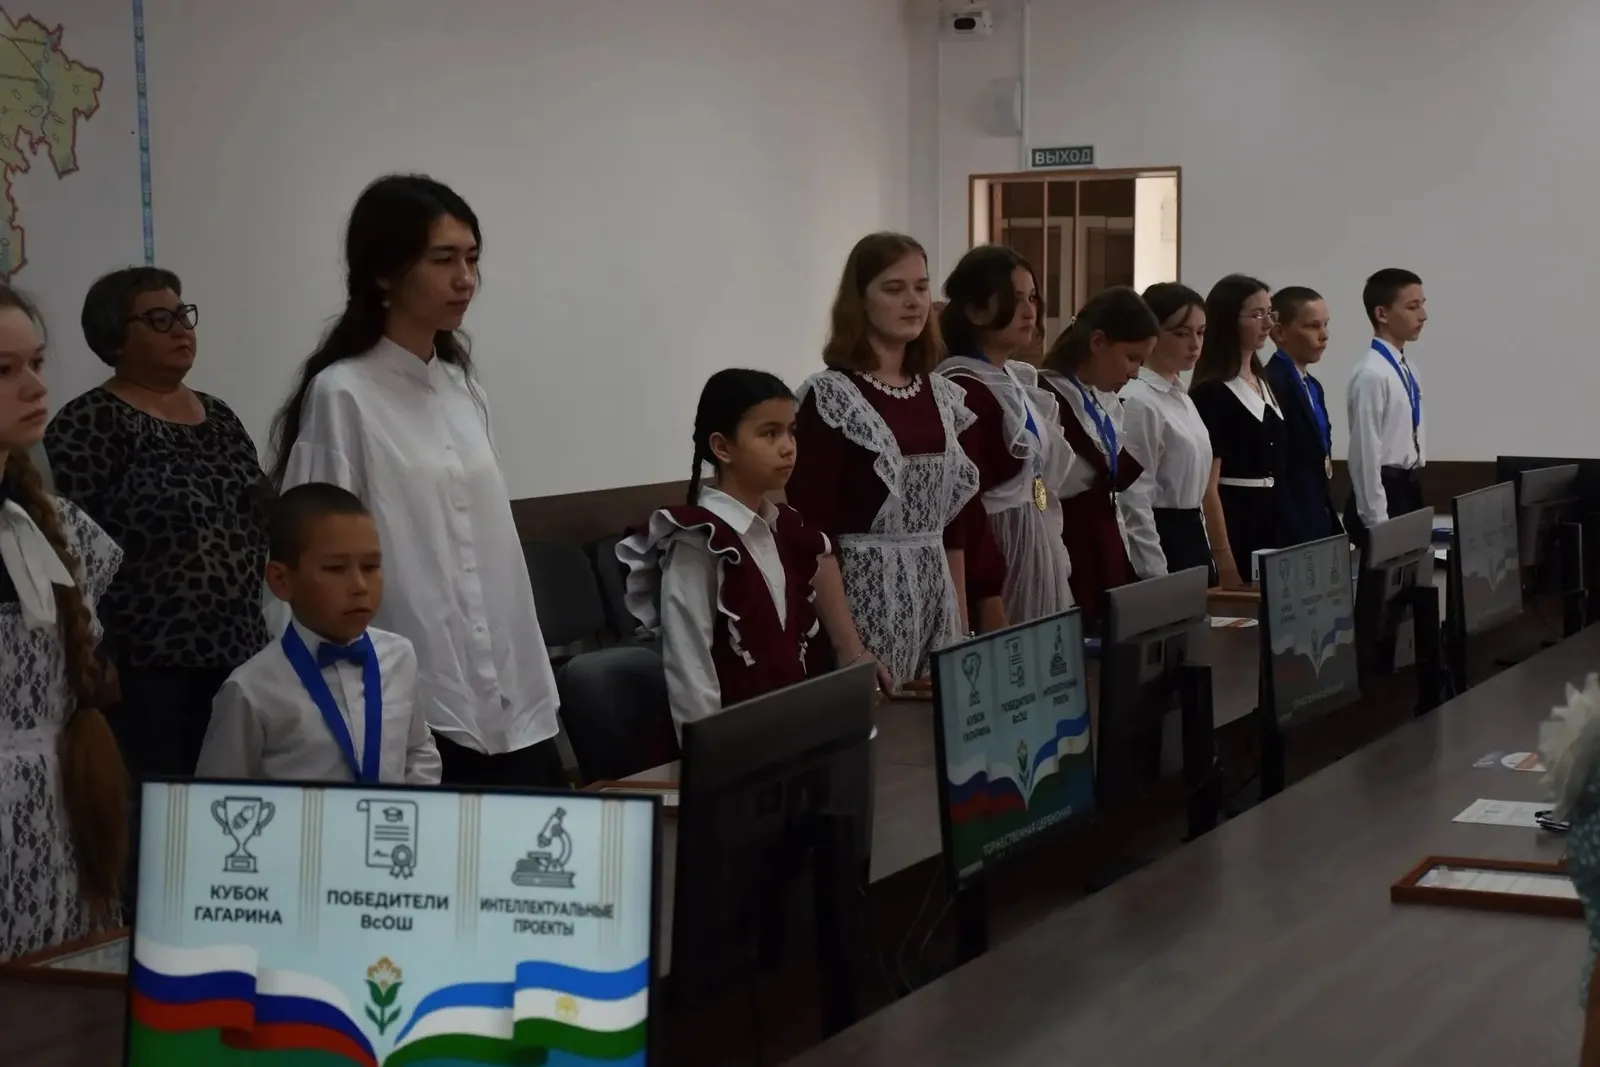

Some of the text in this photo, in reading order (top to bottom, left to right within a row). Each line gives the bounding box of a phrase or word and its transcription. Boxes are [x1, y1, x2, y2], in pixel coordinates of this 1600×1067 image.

[1035, 149, 1092, 164] ВЫХОД
[210, 885, 269, 901] КУБОК
[327, 890, 449, 911] ПОБЕДИТЕЛИ
[194, 906, 283, 925] ГАГАРИНА
[480, 898, 614, 919] ИНТЕЛЛЕКТУАЛЬНЫЕ
[360, 914, 413, 931] ВсОШ
[513, 919, 575, 937] ПРОЕКТЫ
